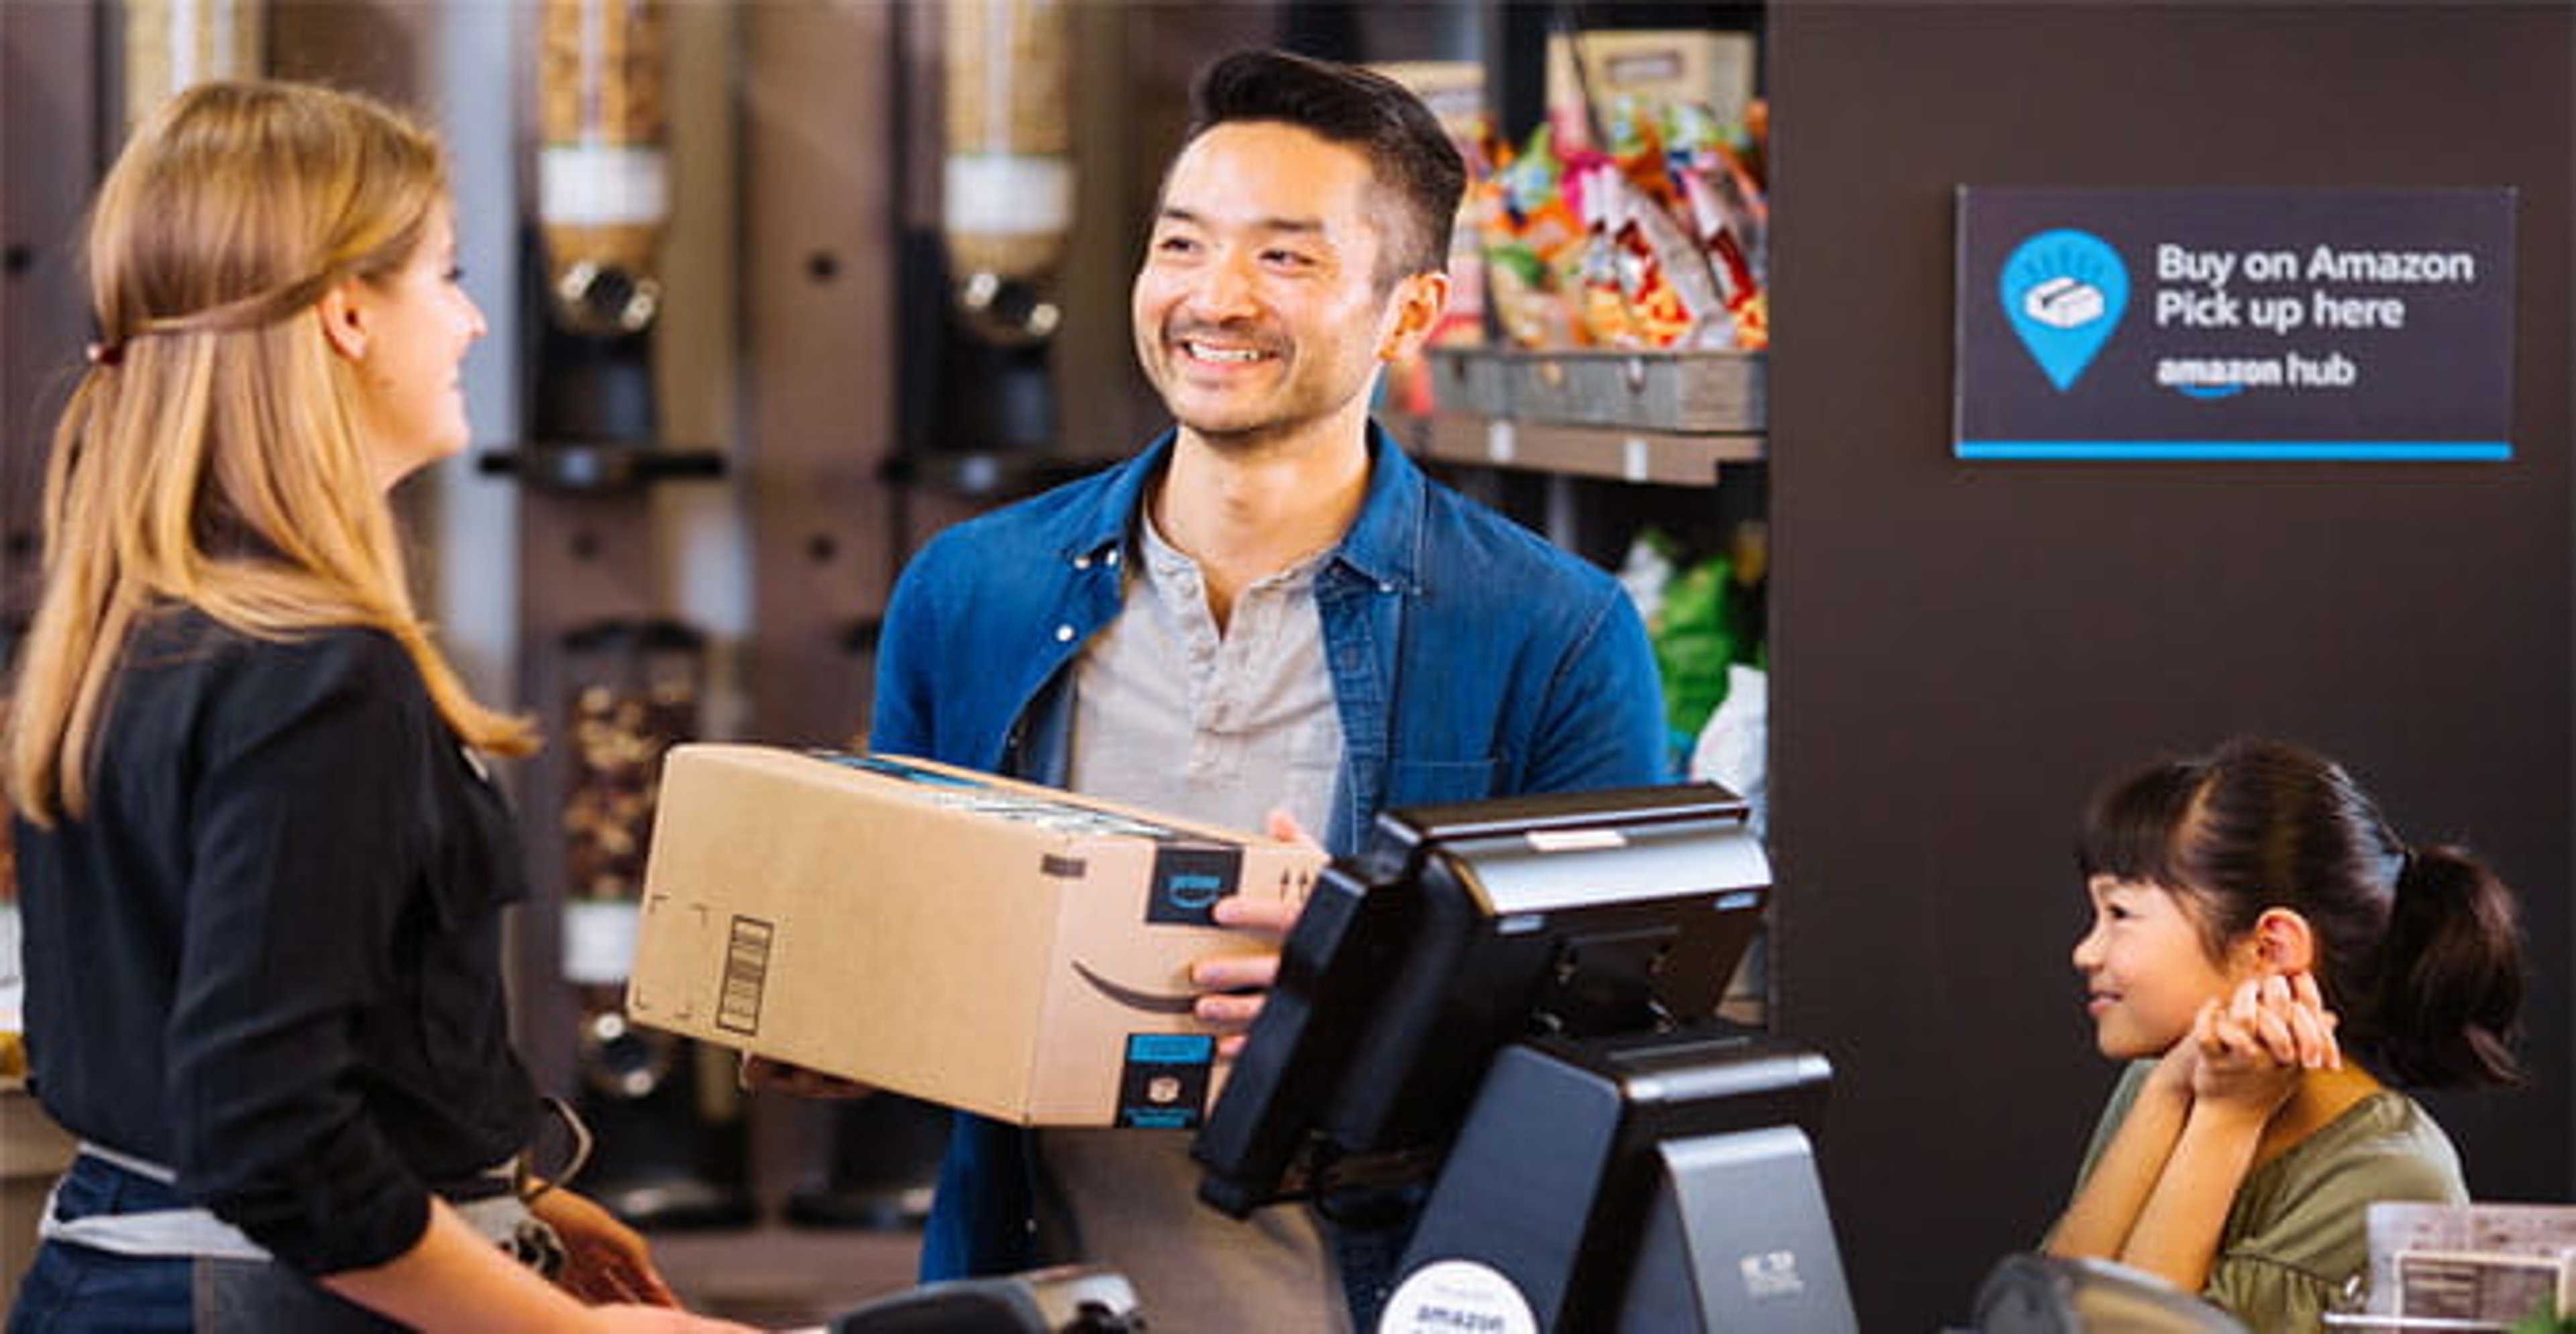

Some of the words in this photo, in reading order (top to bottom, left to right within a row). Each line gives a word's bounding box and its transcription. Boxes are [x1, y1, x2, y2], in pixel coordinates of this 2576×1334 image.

[2156, 243, 2236, 287] Buy
[2243, 252, 2298, 282] on
[2306, 244, 2475, 283] Amazon
[2155, 289, 2241, 328] Pick
[2249, 295, 2304, 336] up
[2313, 289, 2406, 329] here
[2156, 358, 2283, 387] amazon
[2287, 353, 2357, 387] hub
